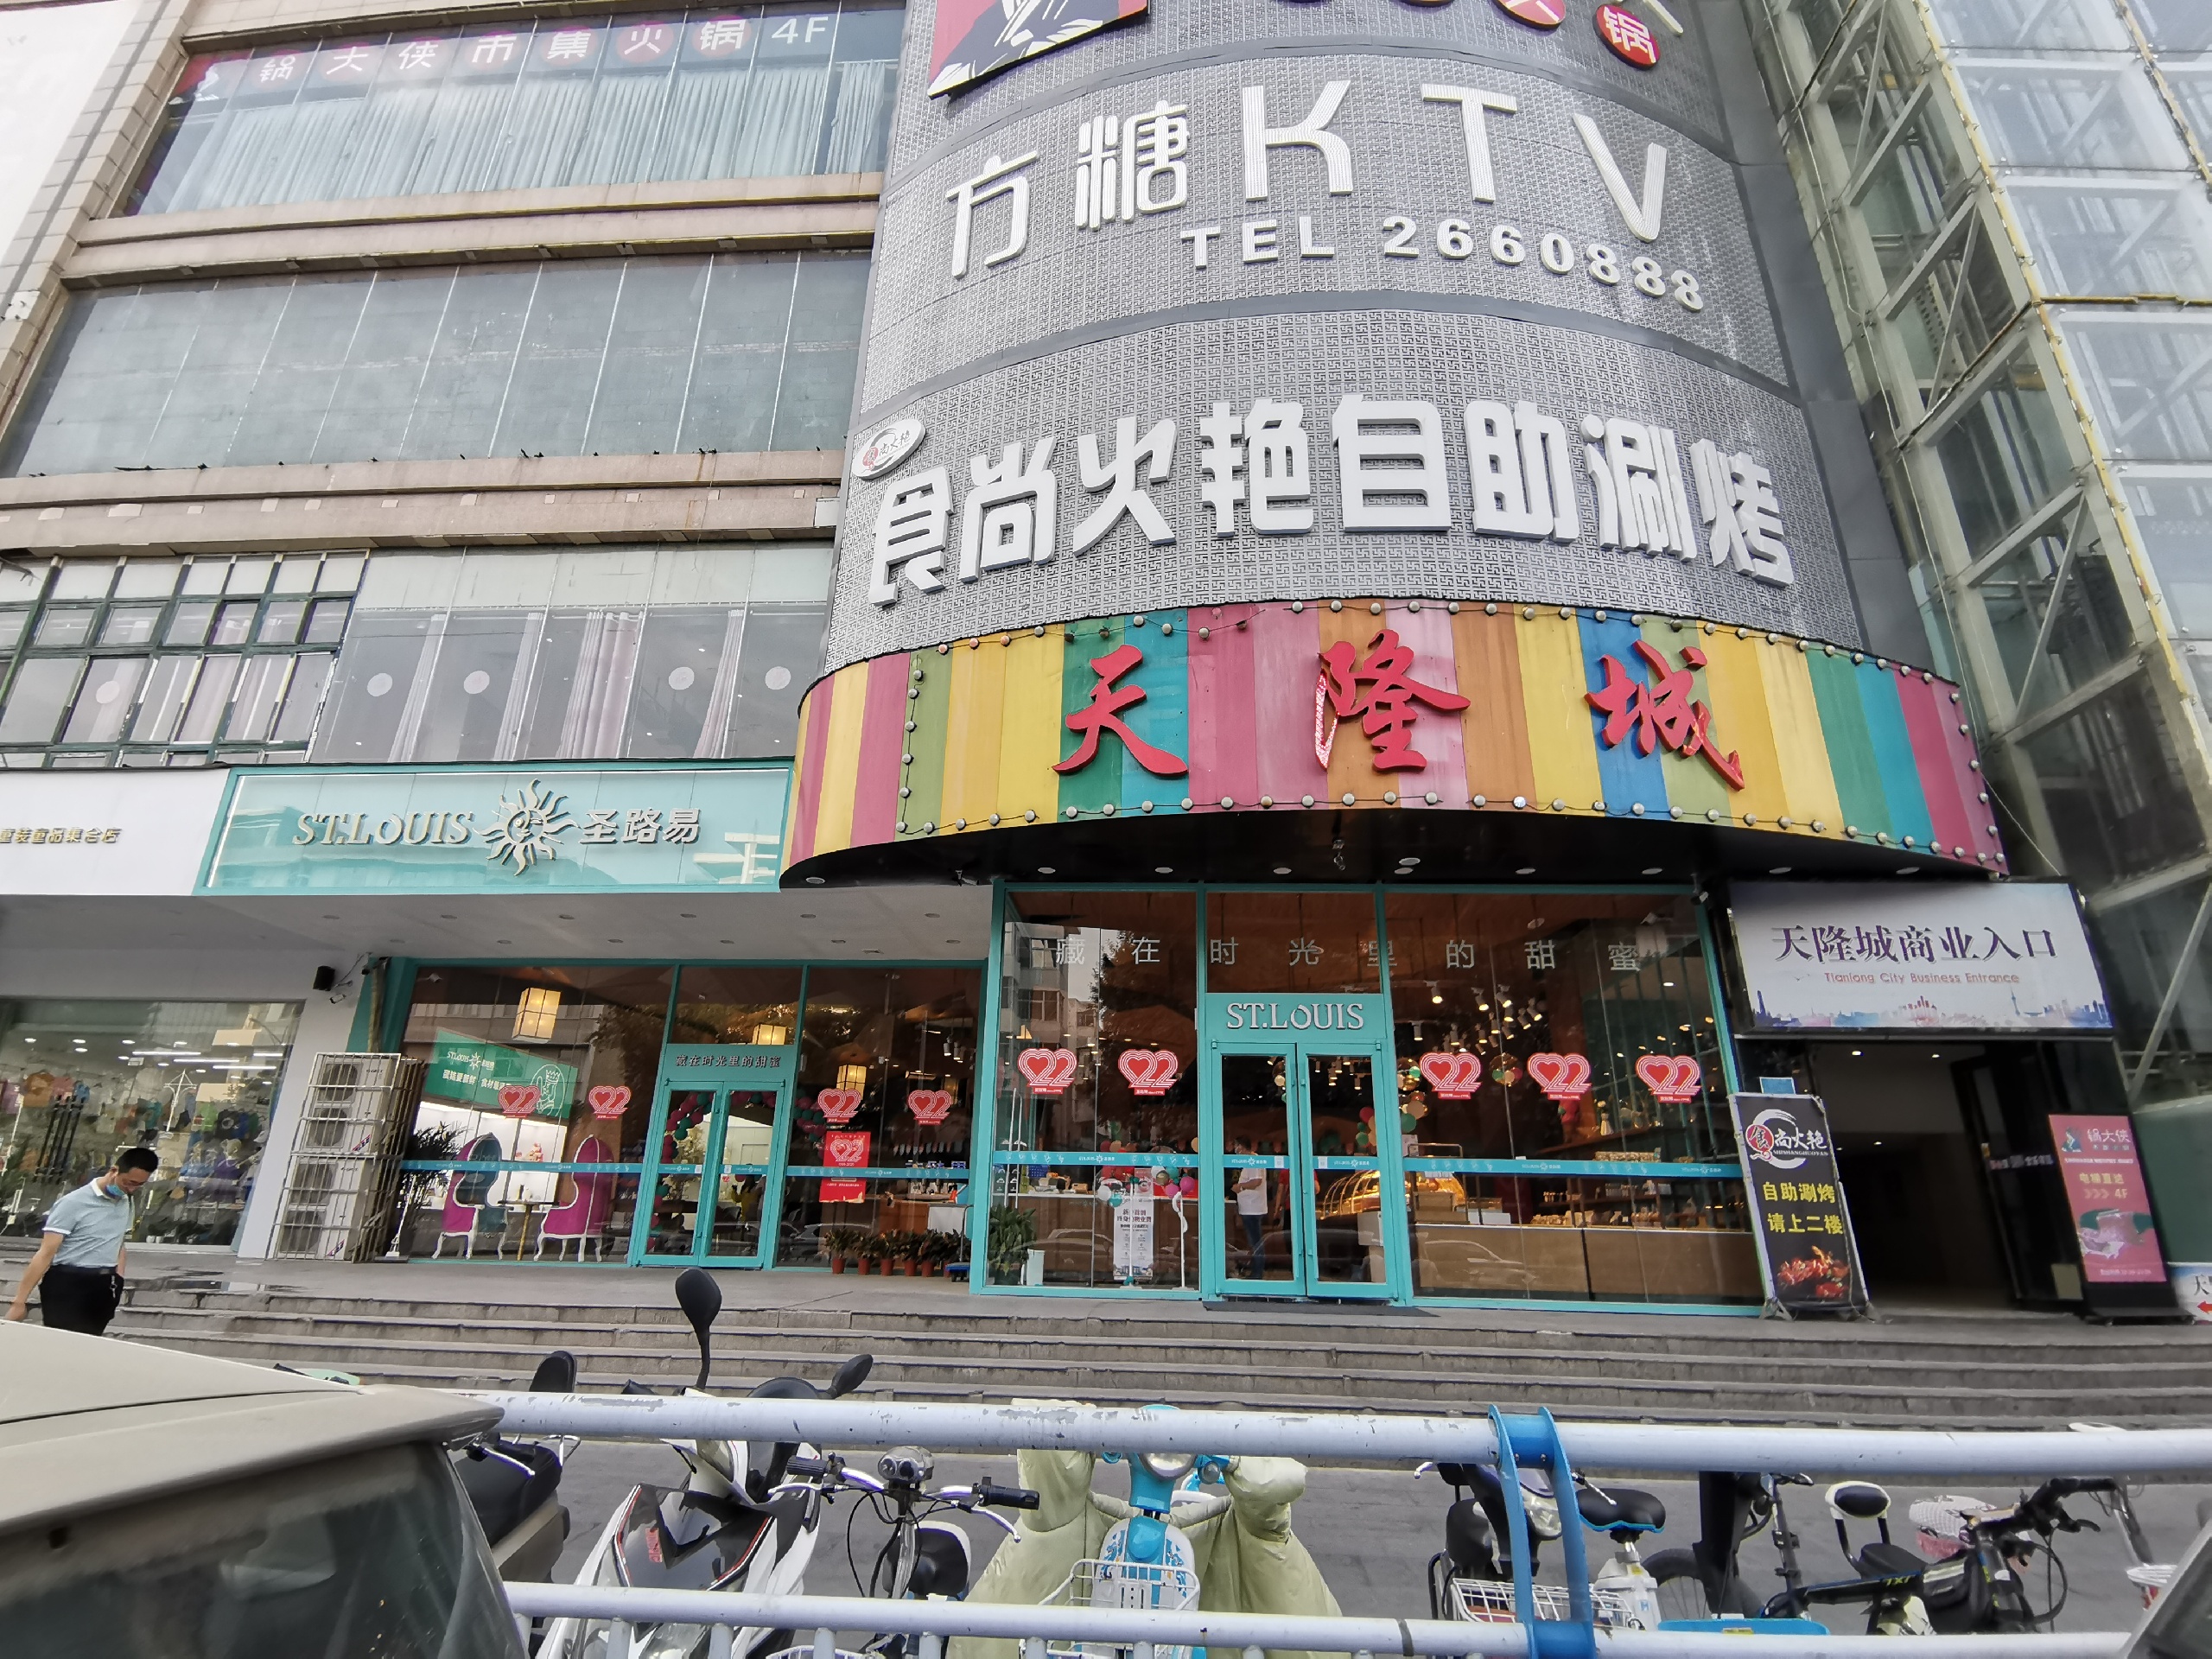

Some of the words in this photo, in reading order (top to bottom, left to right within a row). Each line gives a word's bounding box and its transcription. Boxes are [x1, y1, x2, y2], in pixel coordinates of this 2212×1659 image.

[772, 16, 829, 45] 4F
[1180, 216, 1336, 270] TEL
[1382, 215, 1704, 312] 2660888
[868, 392, 1794, 607] 食尚火艳自助涮烤
[1052, 629, 1745, 791] 天隆城
[292, 811, 474, 845] ST.LOUIS
[578, 808, 702, 845] 圣路易
[1771, 925, 2059, 963] 天隆城商业入口
[1879, 972, 1905, 984] City
[1910, 973, 1961, 983] Business
[1965, 973, 2020, 983] Entrance
[1227, 1002, 1364, 1030] ST.LOUIS
[676, 1055, 781, 1068] 藏在时光里的甜蜜
[1763, 1181, 1835, 1203] 自助涮烤
[1767, 1212, 1843, 1235] 请上二楼
